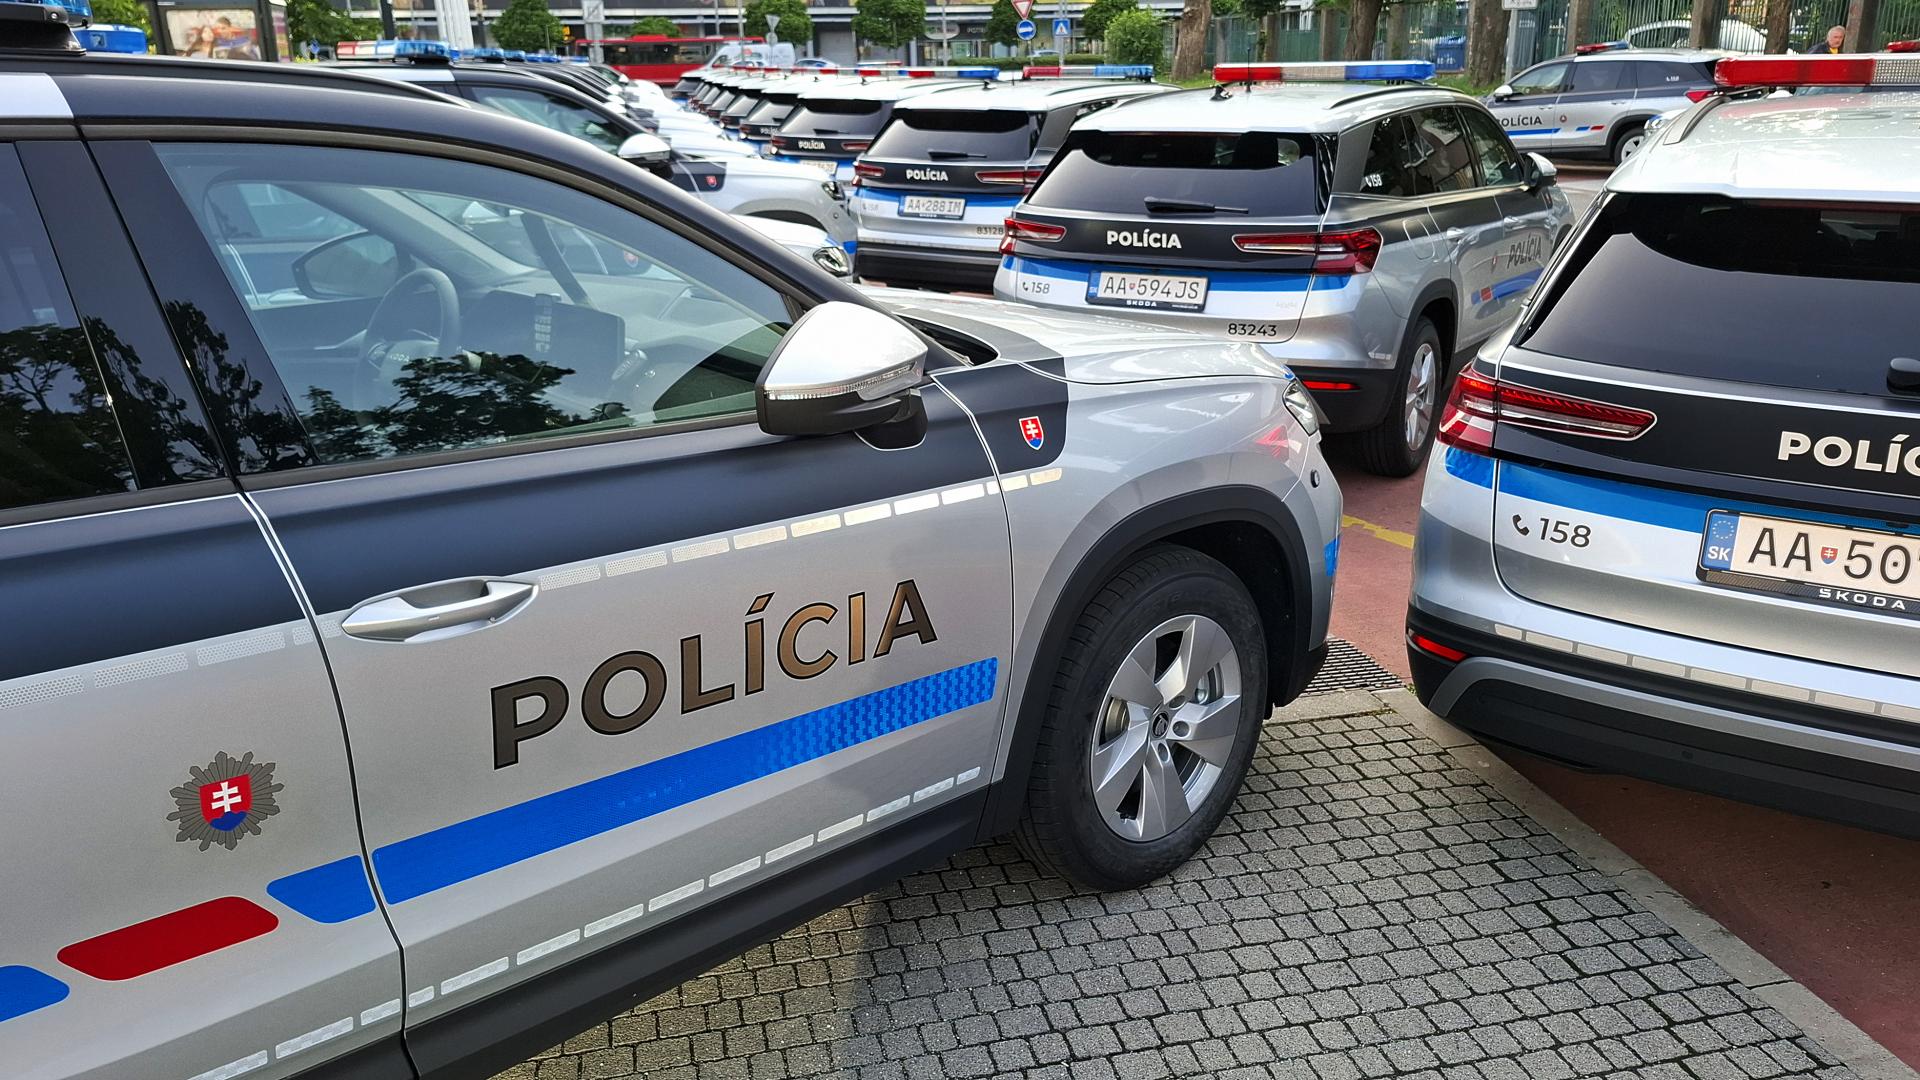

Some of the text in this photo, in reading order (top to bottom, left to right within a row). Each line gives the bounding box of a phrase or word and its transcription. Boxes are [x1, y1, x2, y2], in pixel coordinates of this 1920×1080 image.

[1498, 115, 1542, 127] OLÍCIA
[798, 140, 826, 149] POLÍCIA
[906, 168, 949, 181] POLÍCIA
[907, 199, 920, 210] AA
[1107, 228, 1182, 249] POLÍCIA
[1506, 232, 1542, 269] POLÍCIA
[1031, 281, 1050, 294] 158
[1103, 276, 1126, 295] AA
[1228, 323, 1277, 337] 83243
[1540, 517, 1592, 548] 158
[1708, 545, 1730, 561] SK
[1748, 527, 1920, 585] AA 50
[489, 577, 939, 772] POLÍCIA
